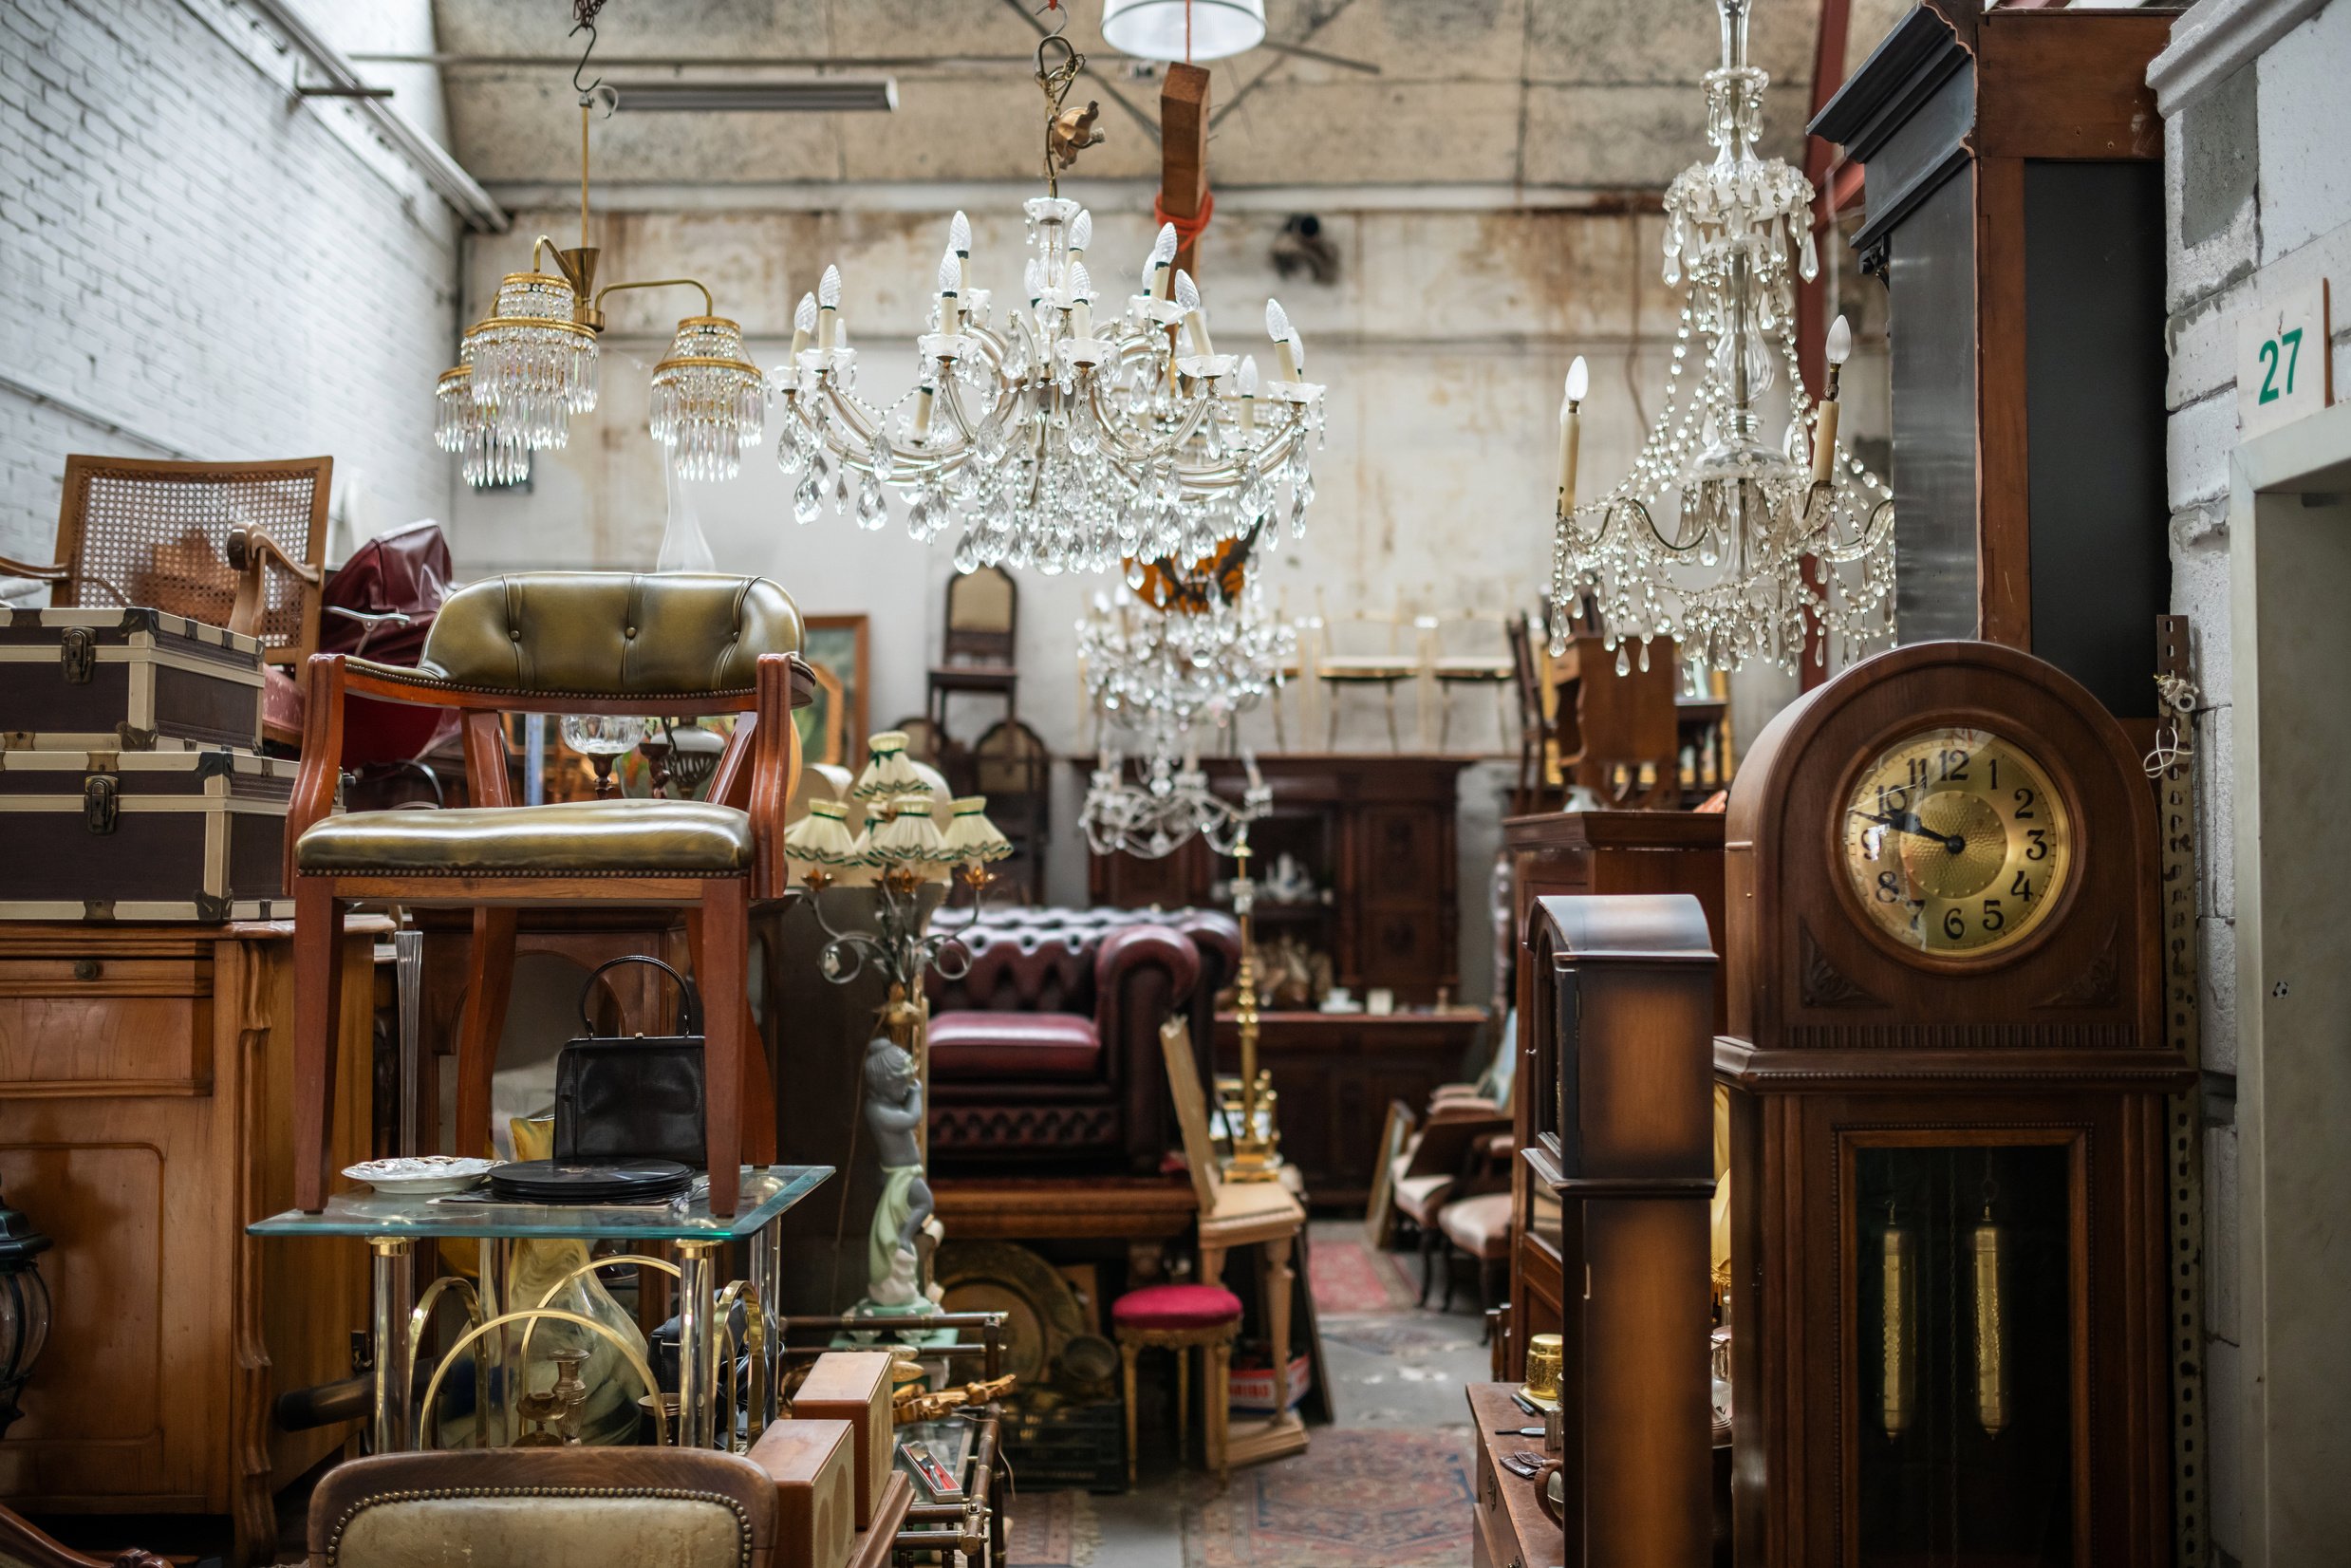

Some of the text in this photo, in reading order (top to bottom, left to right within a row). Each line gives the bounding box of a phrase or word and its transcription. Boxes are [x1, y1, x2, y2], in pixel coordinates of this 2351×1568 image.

[2259, 327, 2303, 405] 27
[1938, 750, 1970, 781] 12
[1987, 758, 1999, 790] 1
[1876, 785, 1908, 818] 10
[2014, 789, 2034, 818] 2
[2026, 830, 2047, 860] 3
[1876, 870, 1899, 903] 8
[2010, 870, 2033, 902] 4
[1906, 900, 1925, 930] 7
[1944, 908, 1965, 940] 6
[1983, 900, 2005, 931] 5
